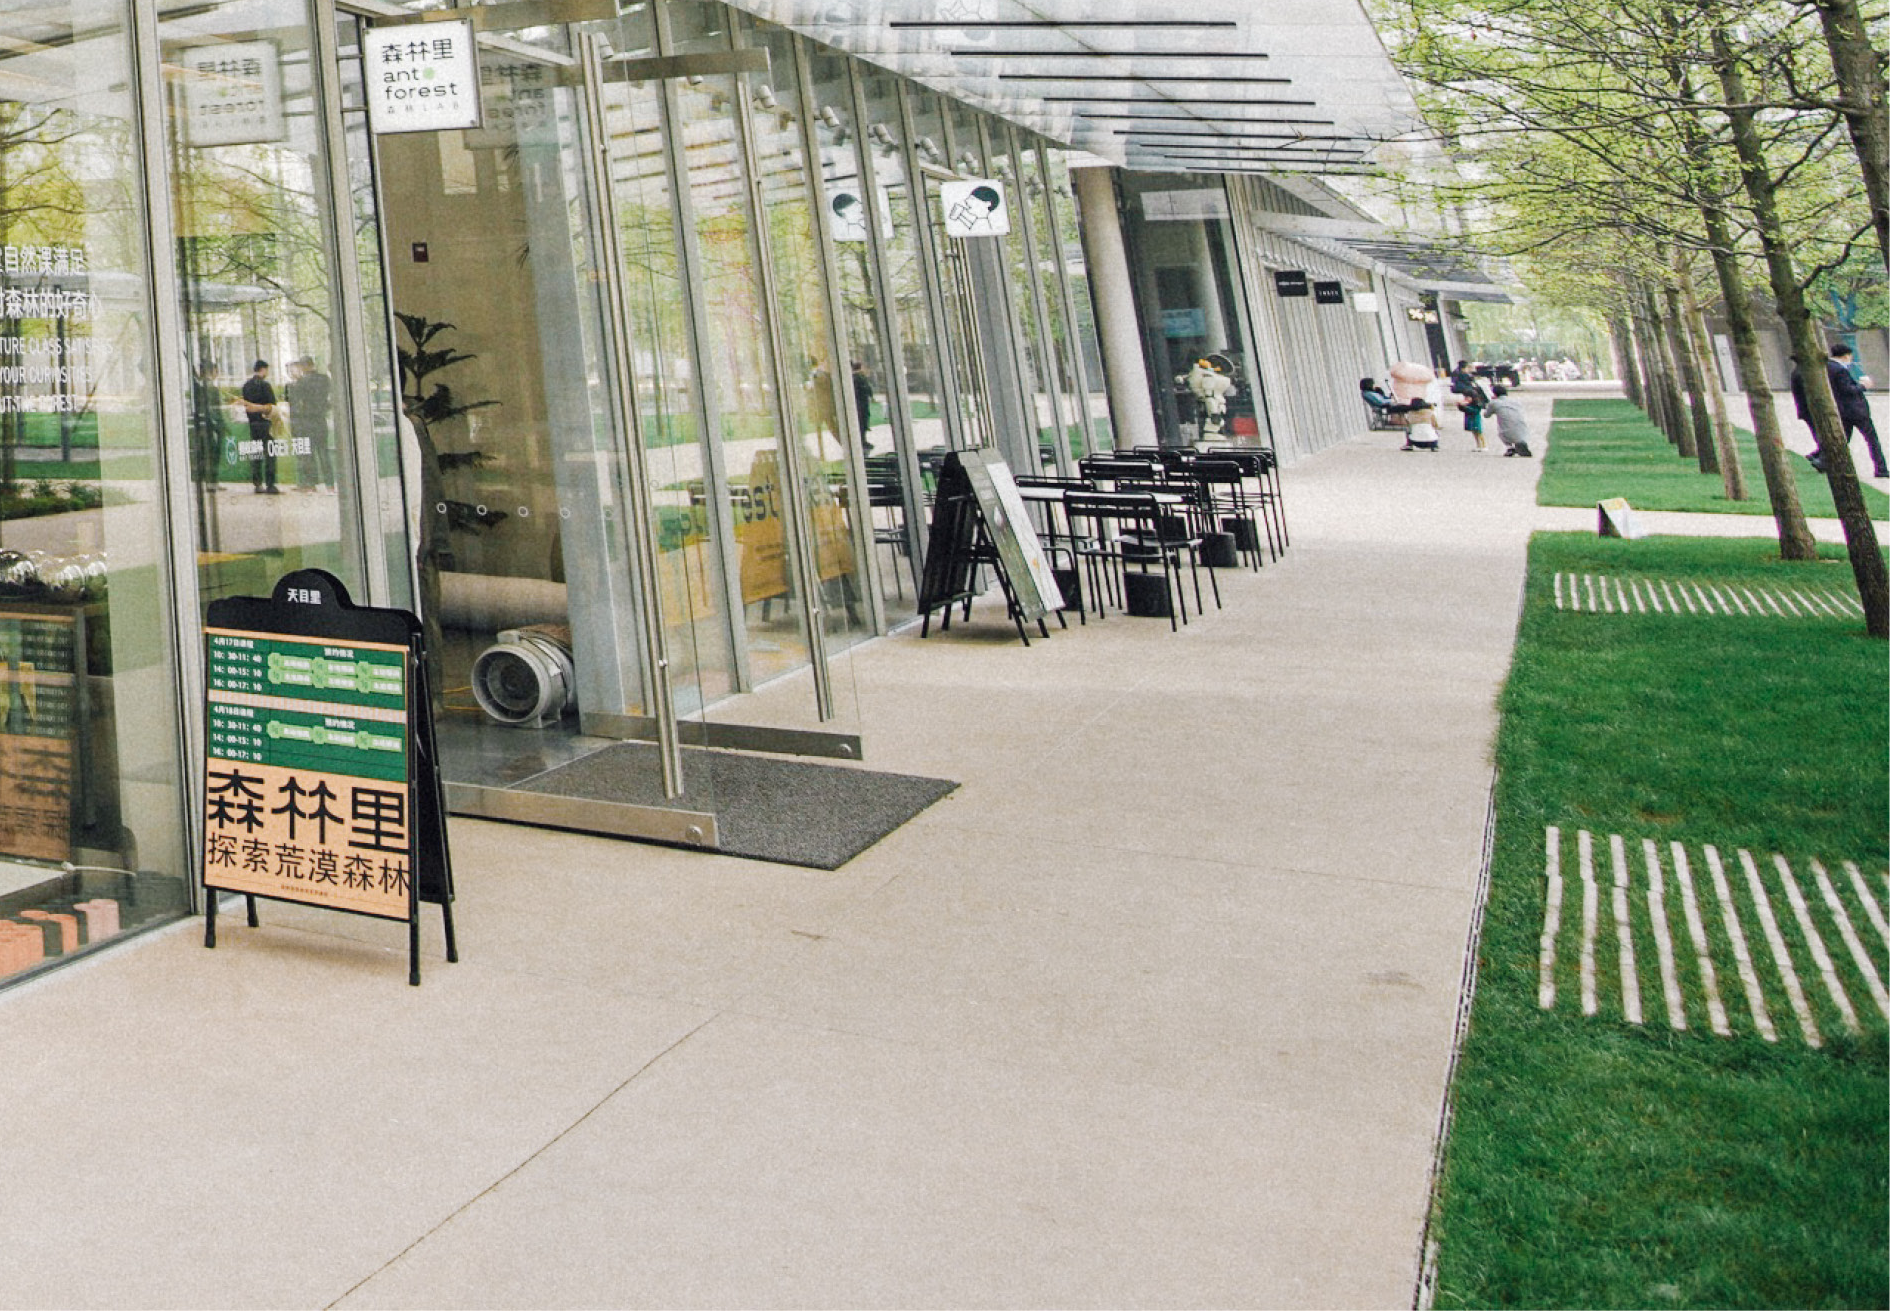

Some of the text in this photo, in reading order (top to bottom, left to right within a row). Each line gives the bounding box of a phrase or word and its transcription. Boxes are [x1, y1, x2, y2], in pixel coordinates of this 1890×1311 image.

[382, 38, 454, 64] 森林里
[383, 68, 420, 83] ant
[385, 82, 458, 100] forest
[29, 337, 63, 354] CLASS
[29, 366, 93, 383] CURIOSITIES
[14, 396, 37, 412] THE
[39, 395, 78, 412] FOREST
[287, 587, 322, 605] 天目里
[208, 768, 409, 855] 森林里
[208, 831, 410, 897] 探索荒漠森林
